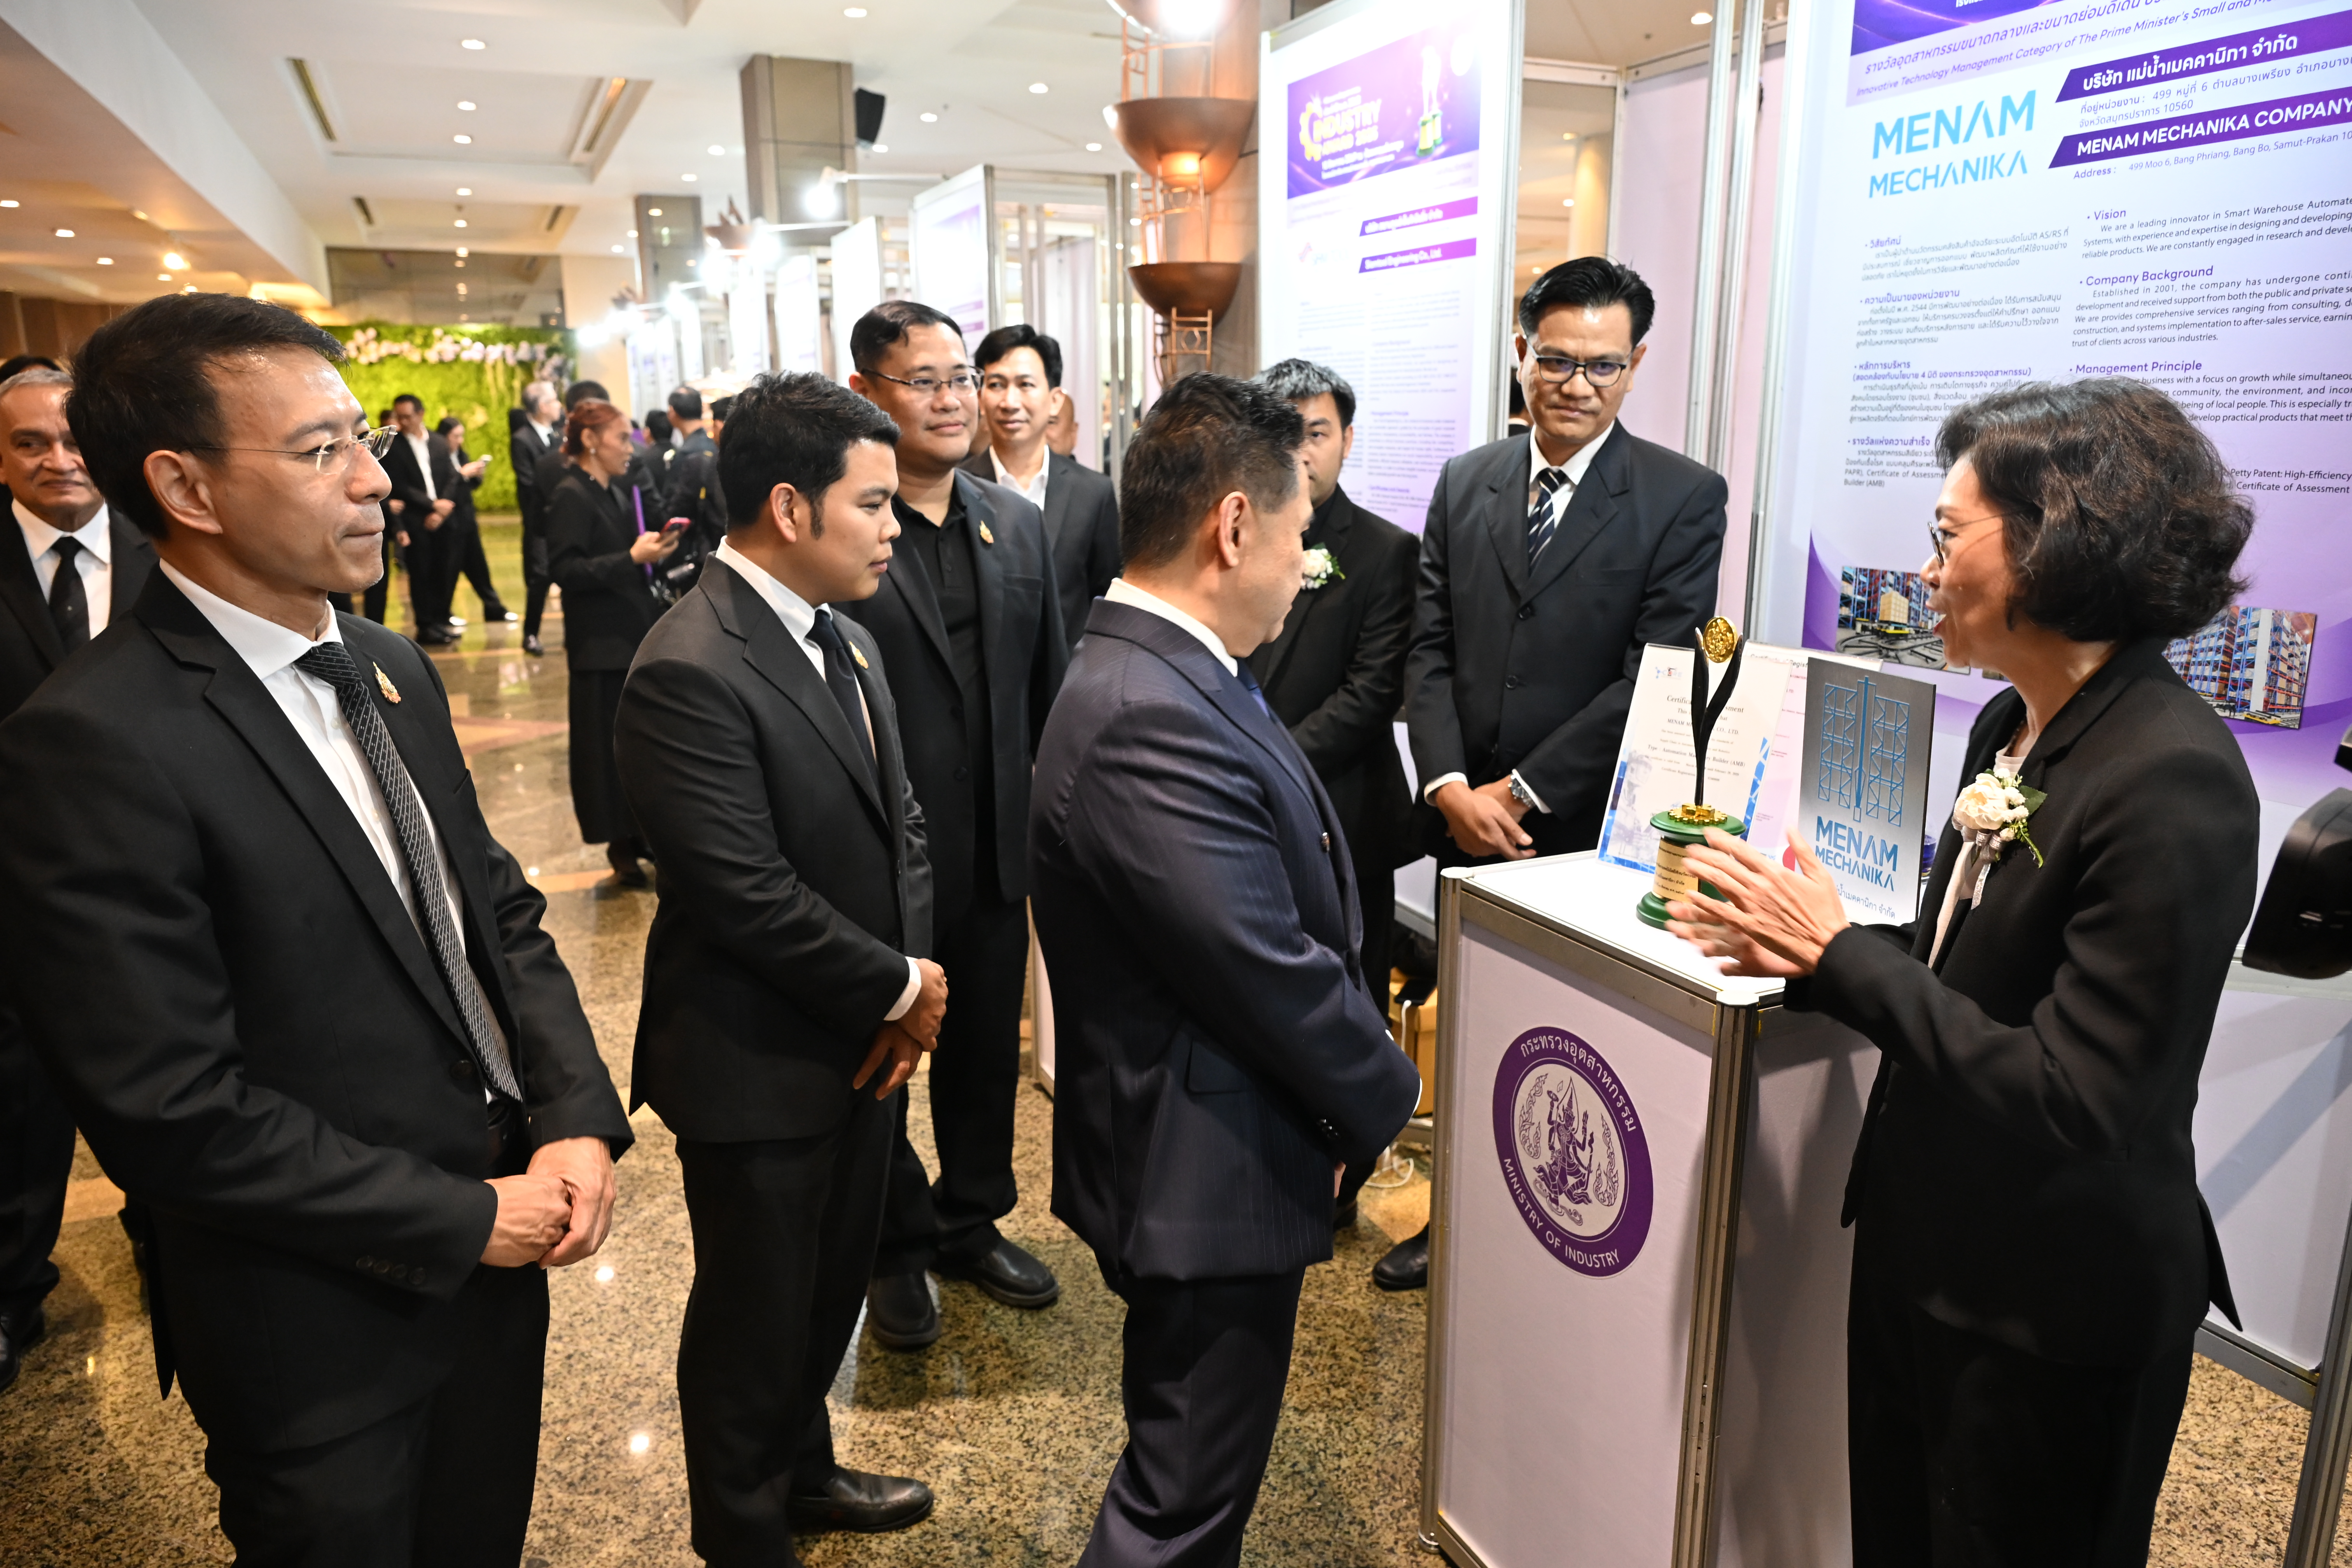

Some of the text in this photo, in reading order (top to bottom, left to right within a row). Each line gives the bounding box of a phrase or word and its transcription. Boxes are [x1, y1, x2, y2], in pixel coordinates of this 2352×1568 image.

[1857, 81, 1899, 96] Innovative
[1902, 70, 1949, 85] Technology
[1951, 52, 2013, 73] Management
[2016, 42, 2062, 59] Category
[2065, 36, 2077, 47] of
[2079, 33, 2098, 44] The
[2100, 26, 2131, 40] Prime
[2133, 11, 2189, 32] Minister's
[2191, 1, 2226, 19] Small
[2083, 34, 2298, 90] บริษัท แม่น้ำเมคคานิกา จำกัด
[2153, 89, 2172, 100] 499
[2176, 80, 2197, 98] หมู่ที่
[2202, 82, 2208, 91] 6
[2213, 68, 2291, 89] ตำบลบางเพรียง
[1872, 89, 2036, 159] MENAM
[2079, 99, 2193, 128] จังหวัดสมุทรปราการ 10560
[2077, 98, 2352, 156] MENAM MECHANIKA COMPANY
[2129, 162, 2143, 170] 499
[2165, 158, 2171, 166] 6,
[2174, 156, 2194, 164] Bang
[2197, 151, 2231, 161] Phriang,
[2233, 147, 2255, 156] Bang
[2258, 144, 2271, 152] Bo,
[2273, 134, 2338, 150] Samut-Prakan
[1869, 150, 2028, 199] MECHANIKA
[2074, 168, 2111, 179] Address
[2094, 209, 2126, 220] Vision
[2137, 219, 2166, 228] leading
[2170, 214, 2210, 224] innovator
[2224, 209, 2250, 219] Smart
[2254, 203, 2304, 215] Warehouse
[2039, 229, 2062, 239] AS/RS
[2084, 238, 2113, 247] Systems,
[2115, 234, 2131, 243] with
[2132, 231, 2174, 242] experience
[2175, 228, 2190, 236] and
[2191, 225, 2228, 236] expertise
[2238, 219, 2281, 230] designing
[2282, 215, 2300, 225] and
[2301, 212, 2352, 223] developing
[2082, 250, 2108, 259] reliable
[2110, 247, 2144, 257] products.
[2174, 238, 2215, 250] constantly
[2217, 234, 2254, 246] engaged
[2266, 229, 2303, 240] research
[2305, 227, 2323, 237] and
[2086, 265, 2213, 286] Company Background
[2093, 287, 2139, 298] Established
[2154, 285, 2177, 293] 2001,
[2182, 283, 2196, 291] the
[2200, 281, 2242, 290] company
[2266, 275, 2320, 285] undergone
[2076, 286, 2344, 311] development and received support from both the public and private
[2178, 333, 2218, 342] industries.
[2076, 360, 2202, 377] Management Principle
[2177, 375, 2193, 383] with
[2203, 374, 2224, 383] focus
[2239, 373, 2270, 384] growth
[2272, 373, 2296, 381] while
[2172, 388, 2221, 397] community,
[2243, 387, 2303, 395] environment,
[2307, 385, 2325, 394] and
[2181, 401, 2204, 410] being
[2206, 400, 2215, 408] of
[2236, 400, 2268, 410] people.
[2270, 399, 2287, 408] This
[2289, 400, 2296, 408] is
[2298, 399, 2342, 410] especially
[2188, 413, 2221, 423] develop
[2222, 413, 2258, 423] practical
[2259, 413, 2298, 423] products
[2300, 413, 2318, 421] that
[2230, 468, 2352, 482] Petty Patent: High-Efficiency
[2236, 481, 2350, 494] Certificate of Assessment
[1667, 695, 1691, 705] Certifica
[1816, 815, 1899, 872] MENAM
[1815, 845, 1895, 892] MECHANIKA
[1879, 904, 1896, 919] จำกัด
[1520, 1036, 1636, 1132] กระทรวงอุตสาหกรรม
[1503, 1158, 1619, 1267] MINISTRY OF INDUSTRY
